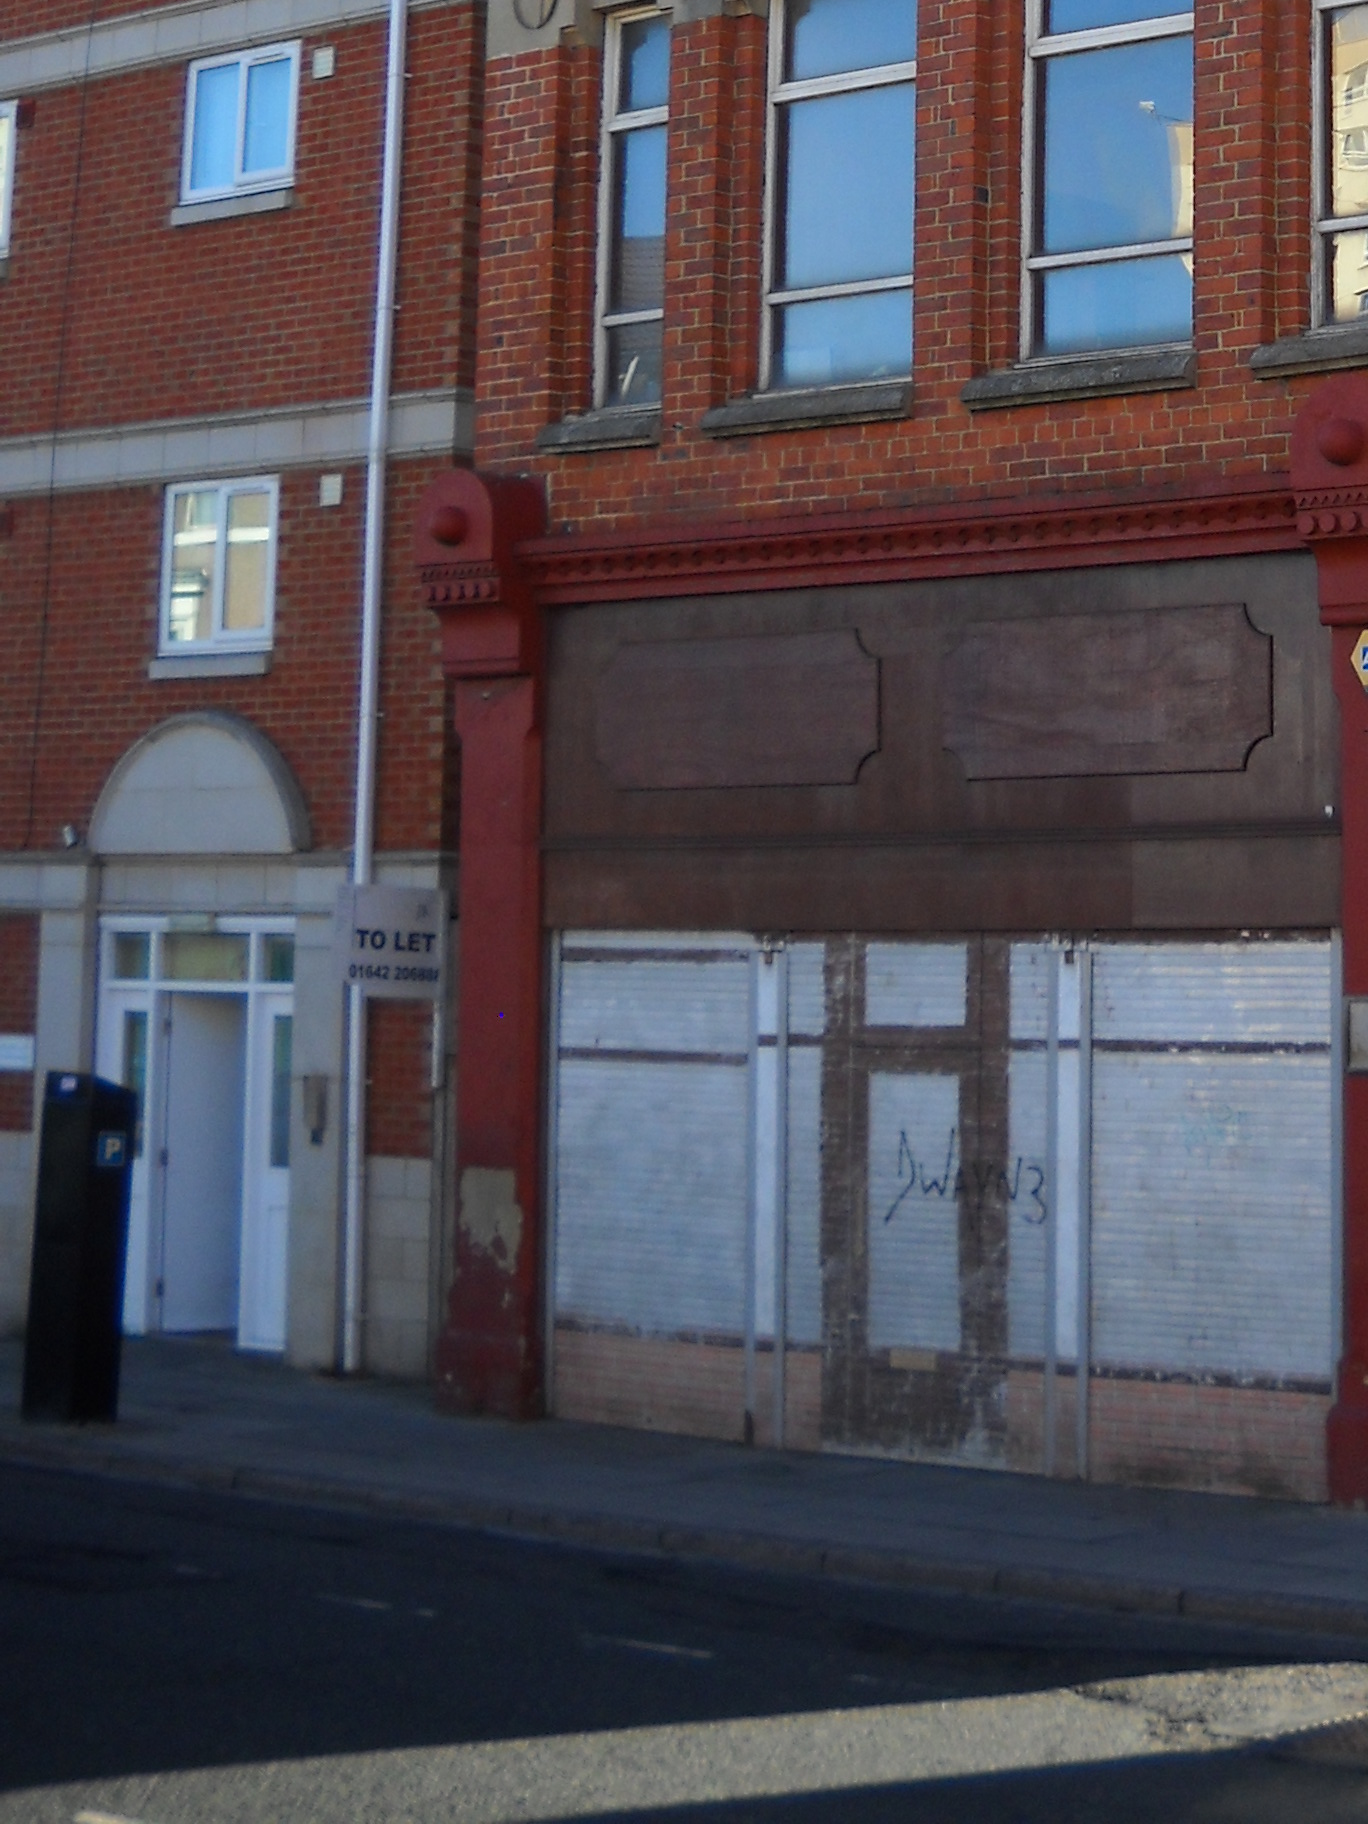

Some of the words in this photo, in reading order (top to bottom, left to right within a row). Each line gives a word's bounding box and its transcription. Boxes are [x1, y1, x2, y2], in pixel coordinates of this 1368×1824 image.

[356, 929, 387, 950] TO
[394, 929, 437, 953] LET
[349, 963, 389, 980] 01642
[105, 1137, 121, 1160] P
